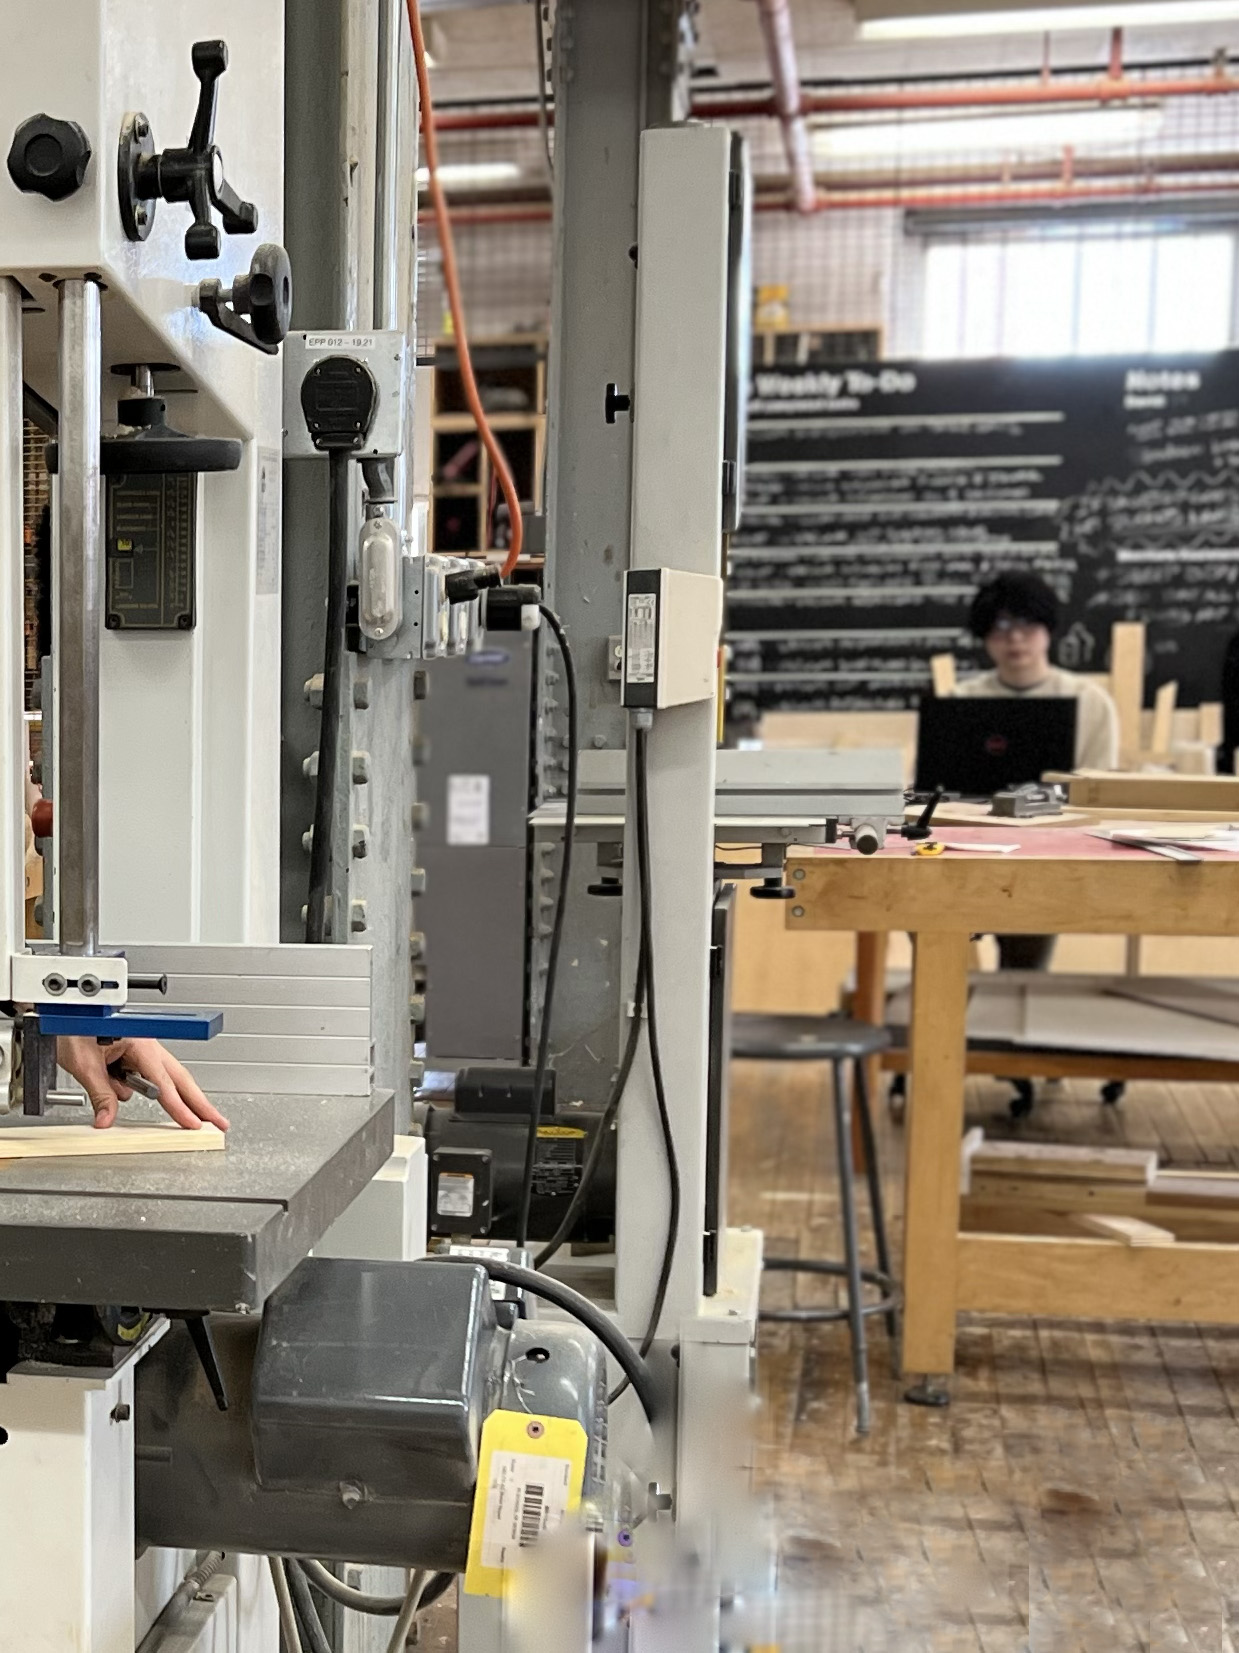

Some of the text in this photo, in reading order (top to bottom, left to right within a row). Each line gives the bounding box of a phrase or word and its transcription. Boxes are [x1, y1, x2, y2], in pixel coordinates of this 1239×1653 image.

[309, 338, 326, 347] EPP
[327, 338, 343, 347] 012
[755, 369, 917, 399] Weekly To-Do
[1125, 369, 1201, 392] Notes
